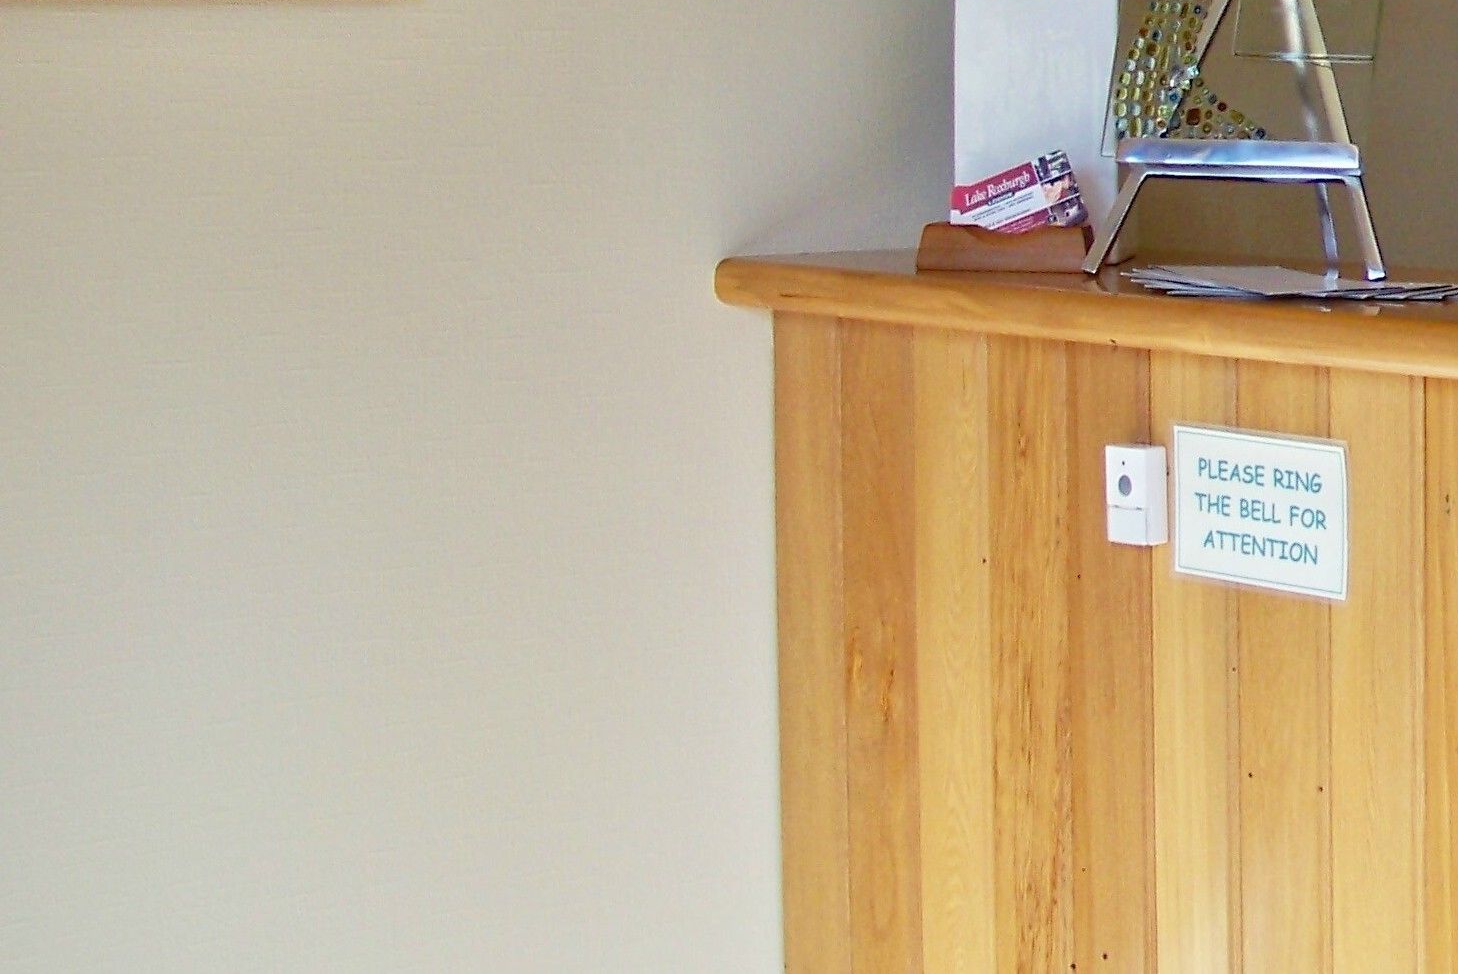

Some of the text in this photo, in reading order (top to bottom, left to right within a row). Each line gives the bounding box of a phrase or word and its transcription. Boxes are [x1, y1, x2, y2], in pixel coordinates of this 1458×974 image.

[964, 189, 986, 206] Lake
[986, 171, 1031, 197] Roxburgh
[1198, 457, 1323, 493] PLEASE RING
[1195, 492, 1327, 530] THE BELL FOR
[1203, 530, 1319, 565] ATTENTION
